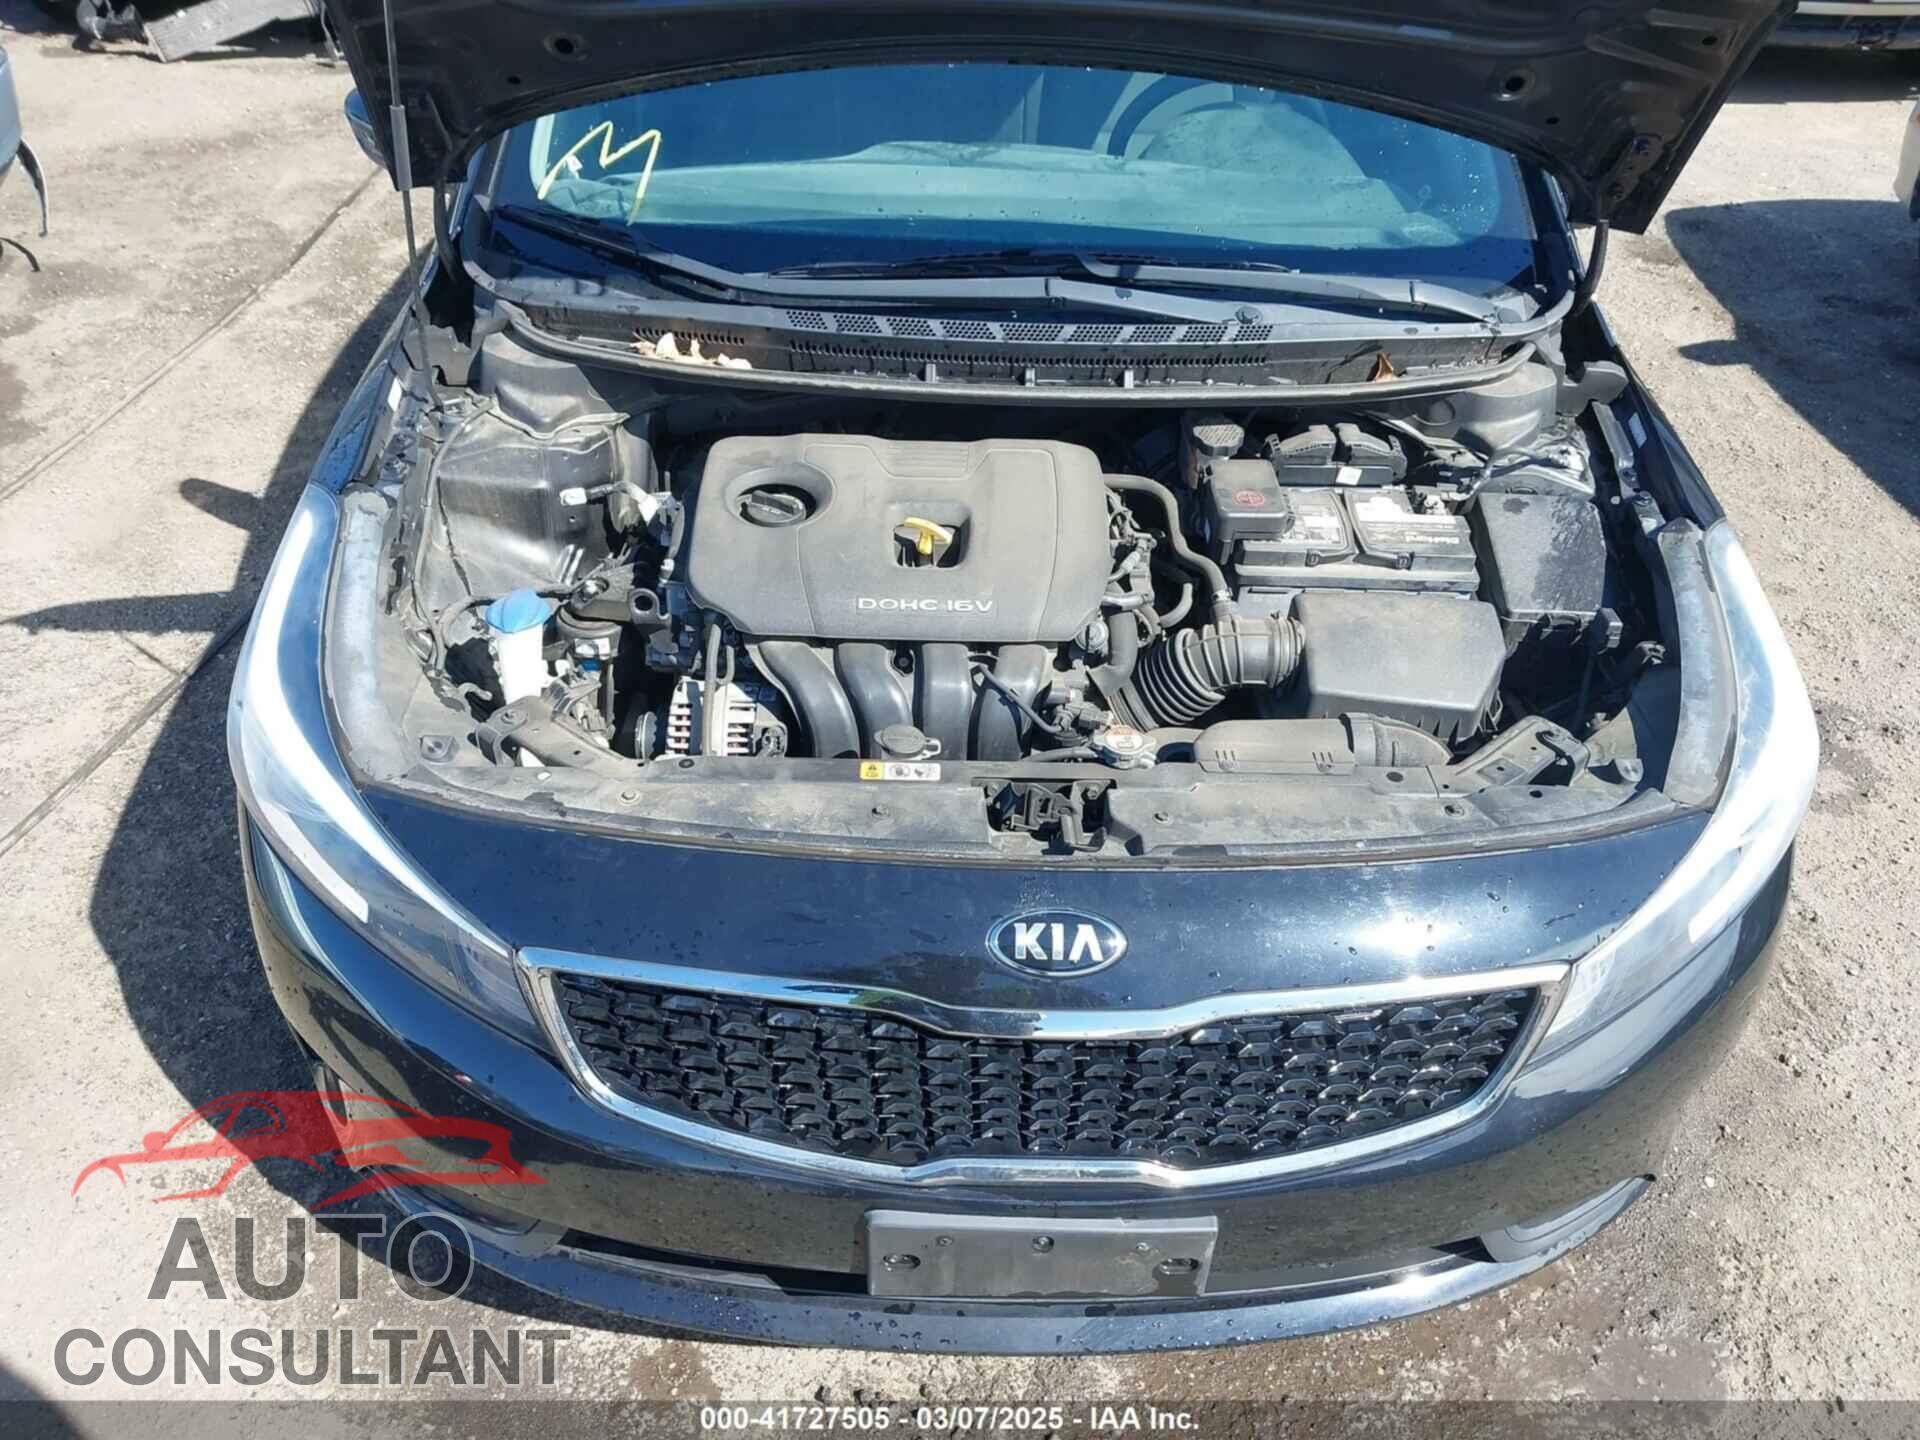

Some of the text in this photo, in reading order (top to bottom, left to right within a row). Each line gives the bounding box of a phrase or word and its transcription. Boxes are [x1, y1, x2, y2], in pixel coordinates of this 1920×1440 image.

[858, 597, 993, 612] DOHC 16V
[1014, 922, 1104, 962] KIA
